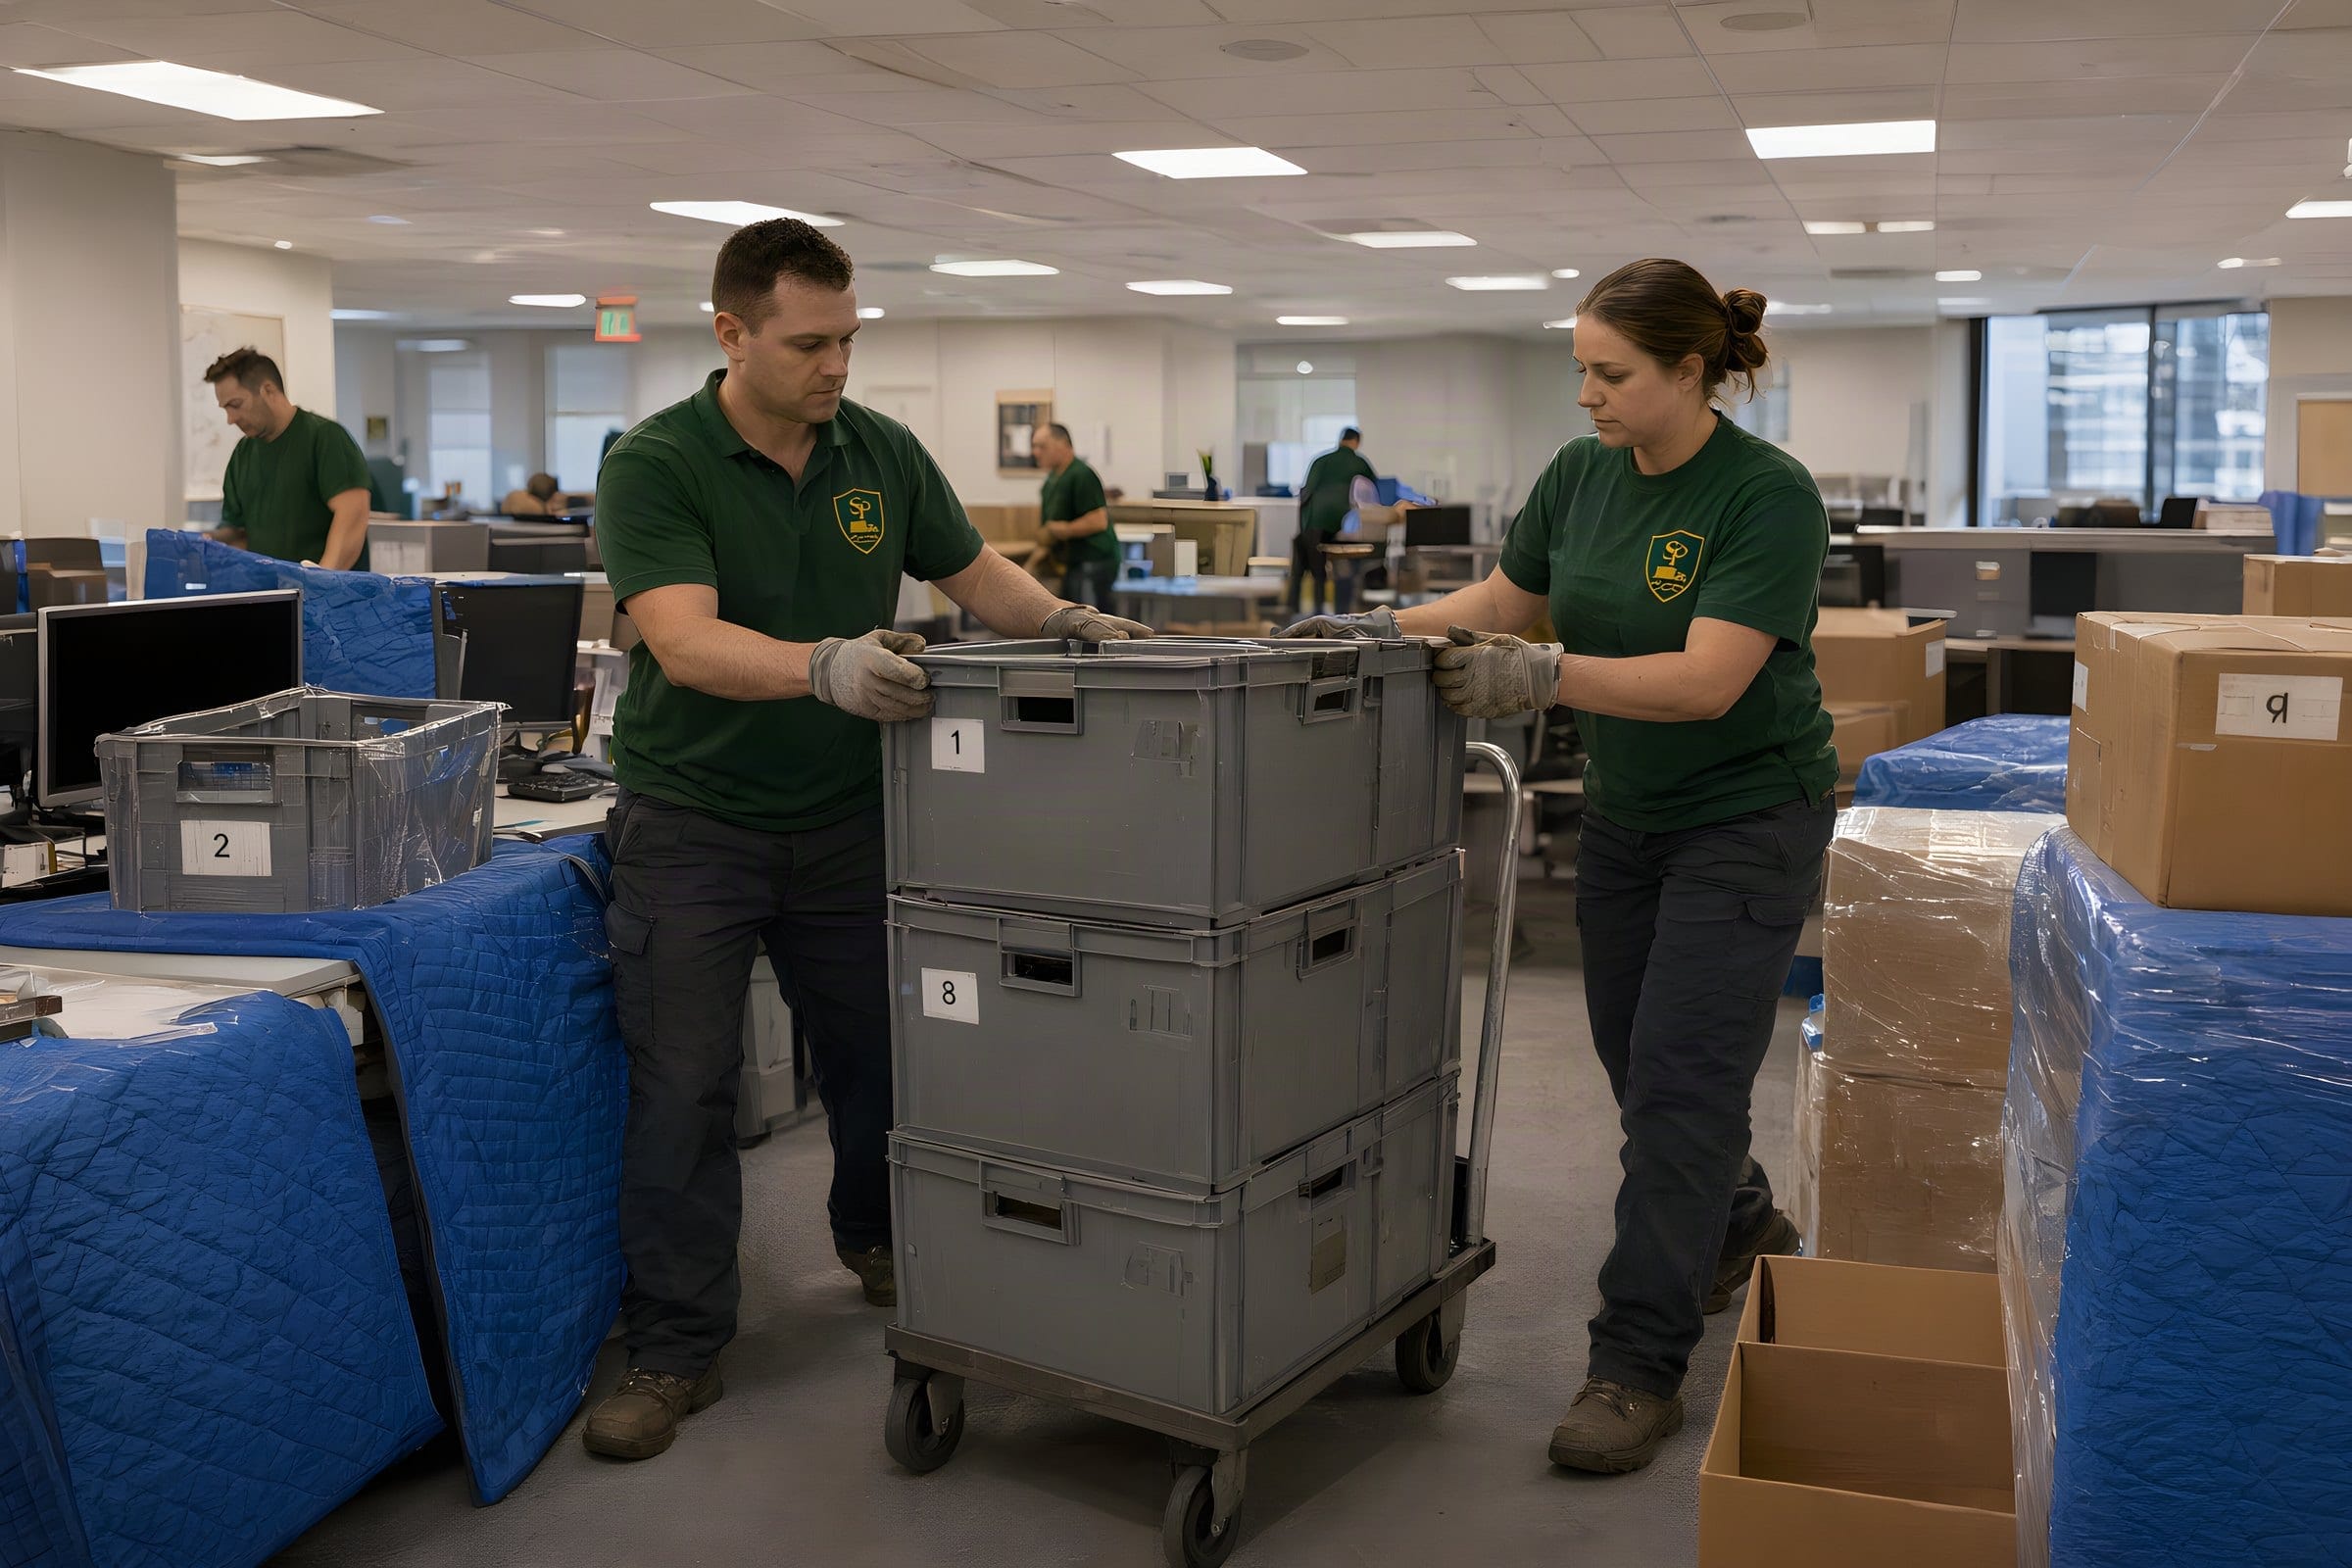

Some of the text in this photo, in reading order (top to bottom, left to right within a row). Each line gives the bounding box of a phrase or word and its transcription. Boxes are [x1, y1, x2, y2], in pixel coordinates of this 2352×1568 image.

[951, 729, 959, 755] 1
[214, 833, 230, 858] 2
[943, 980, 956, 1004] 8
